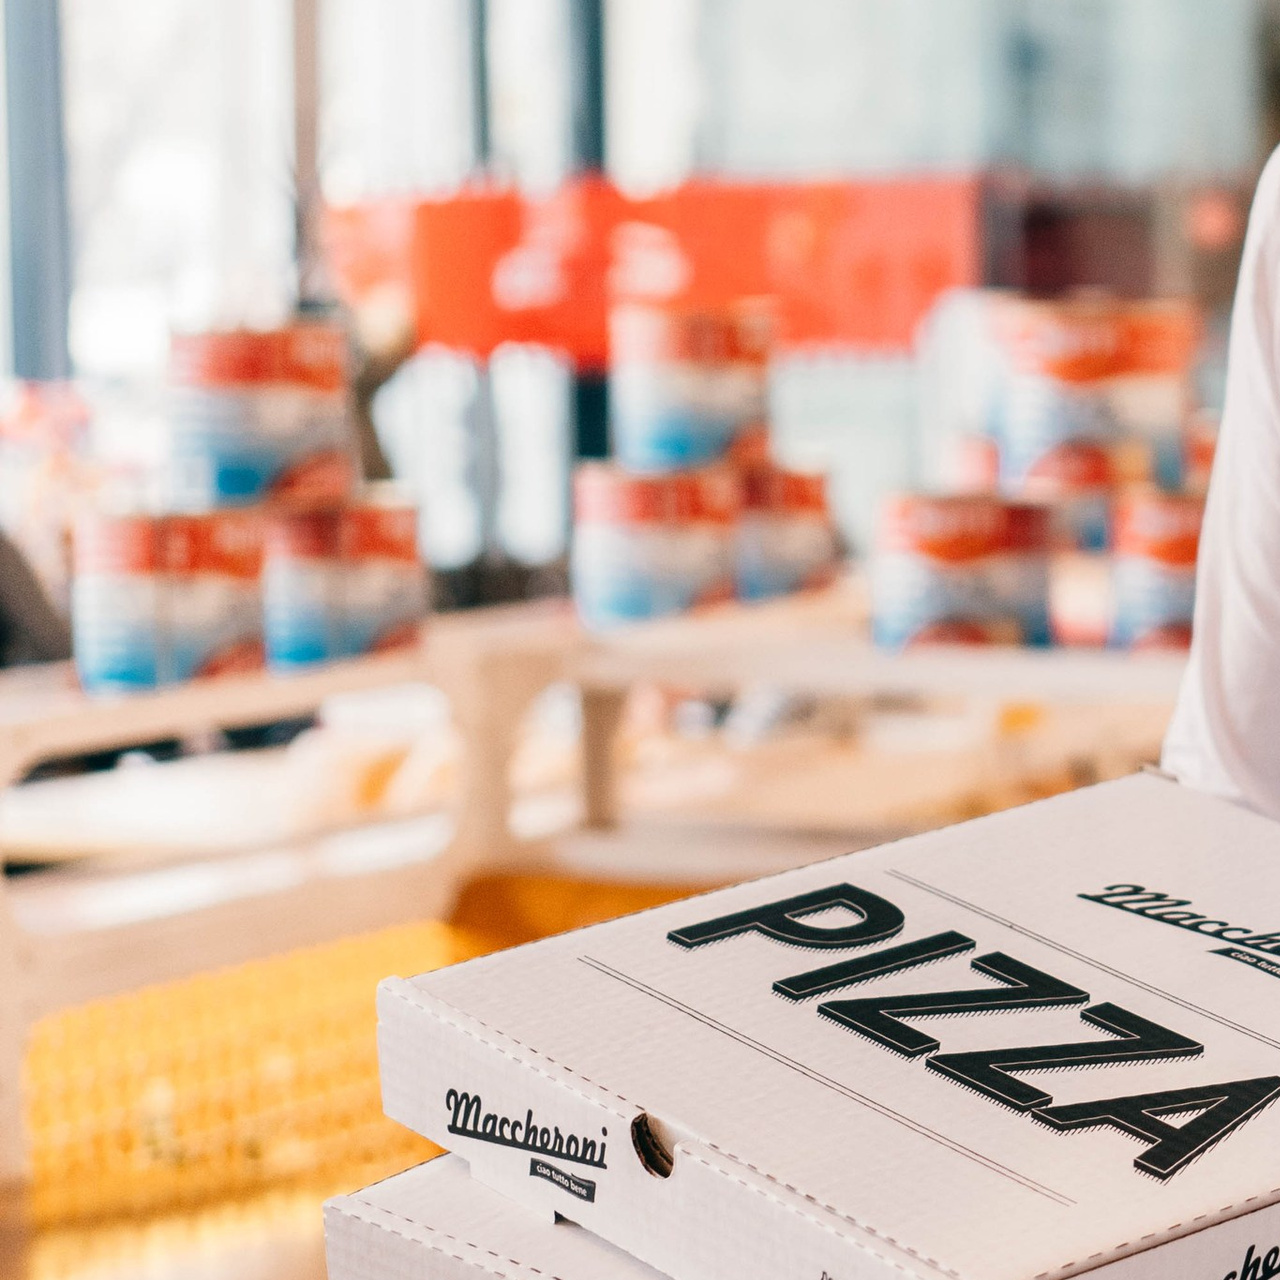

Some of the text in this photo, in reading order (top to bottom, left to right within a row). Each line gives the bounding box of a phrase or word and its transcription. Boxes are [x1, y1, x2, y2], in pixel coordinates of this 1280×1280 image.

[1230, 950, 1258, 964] ciao
[446, 1088, 608, 1169] Maccheroni
[536, 1163, 587, 1197] ciao tutto bene
